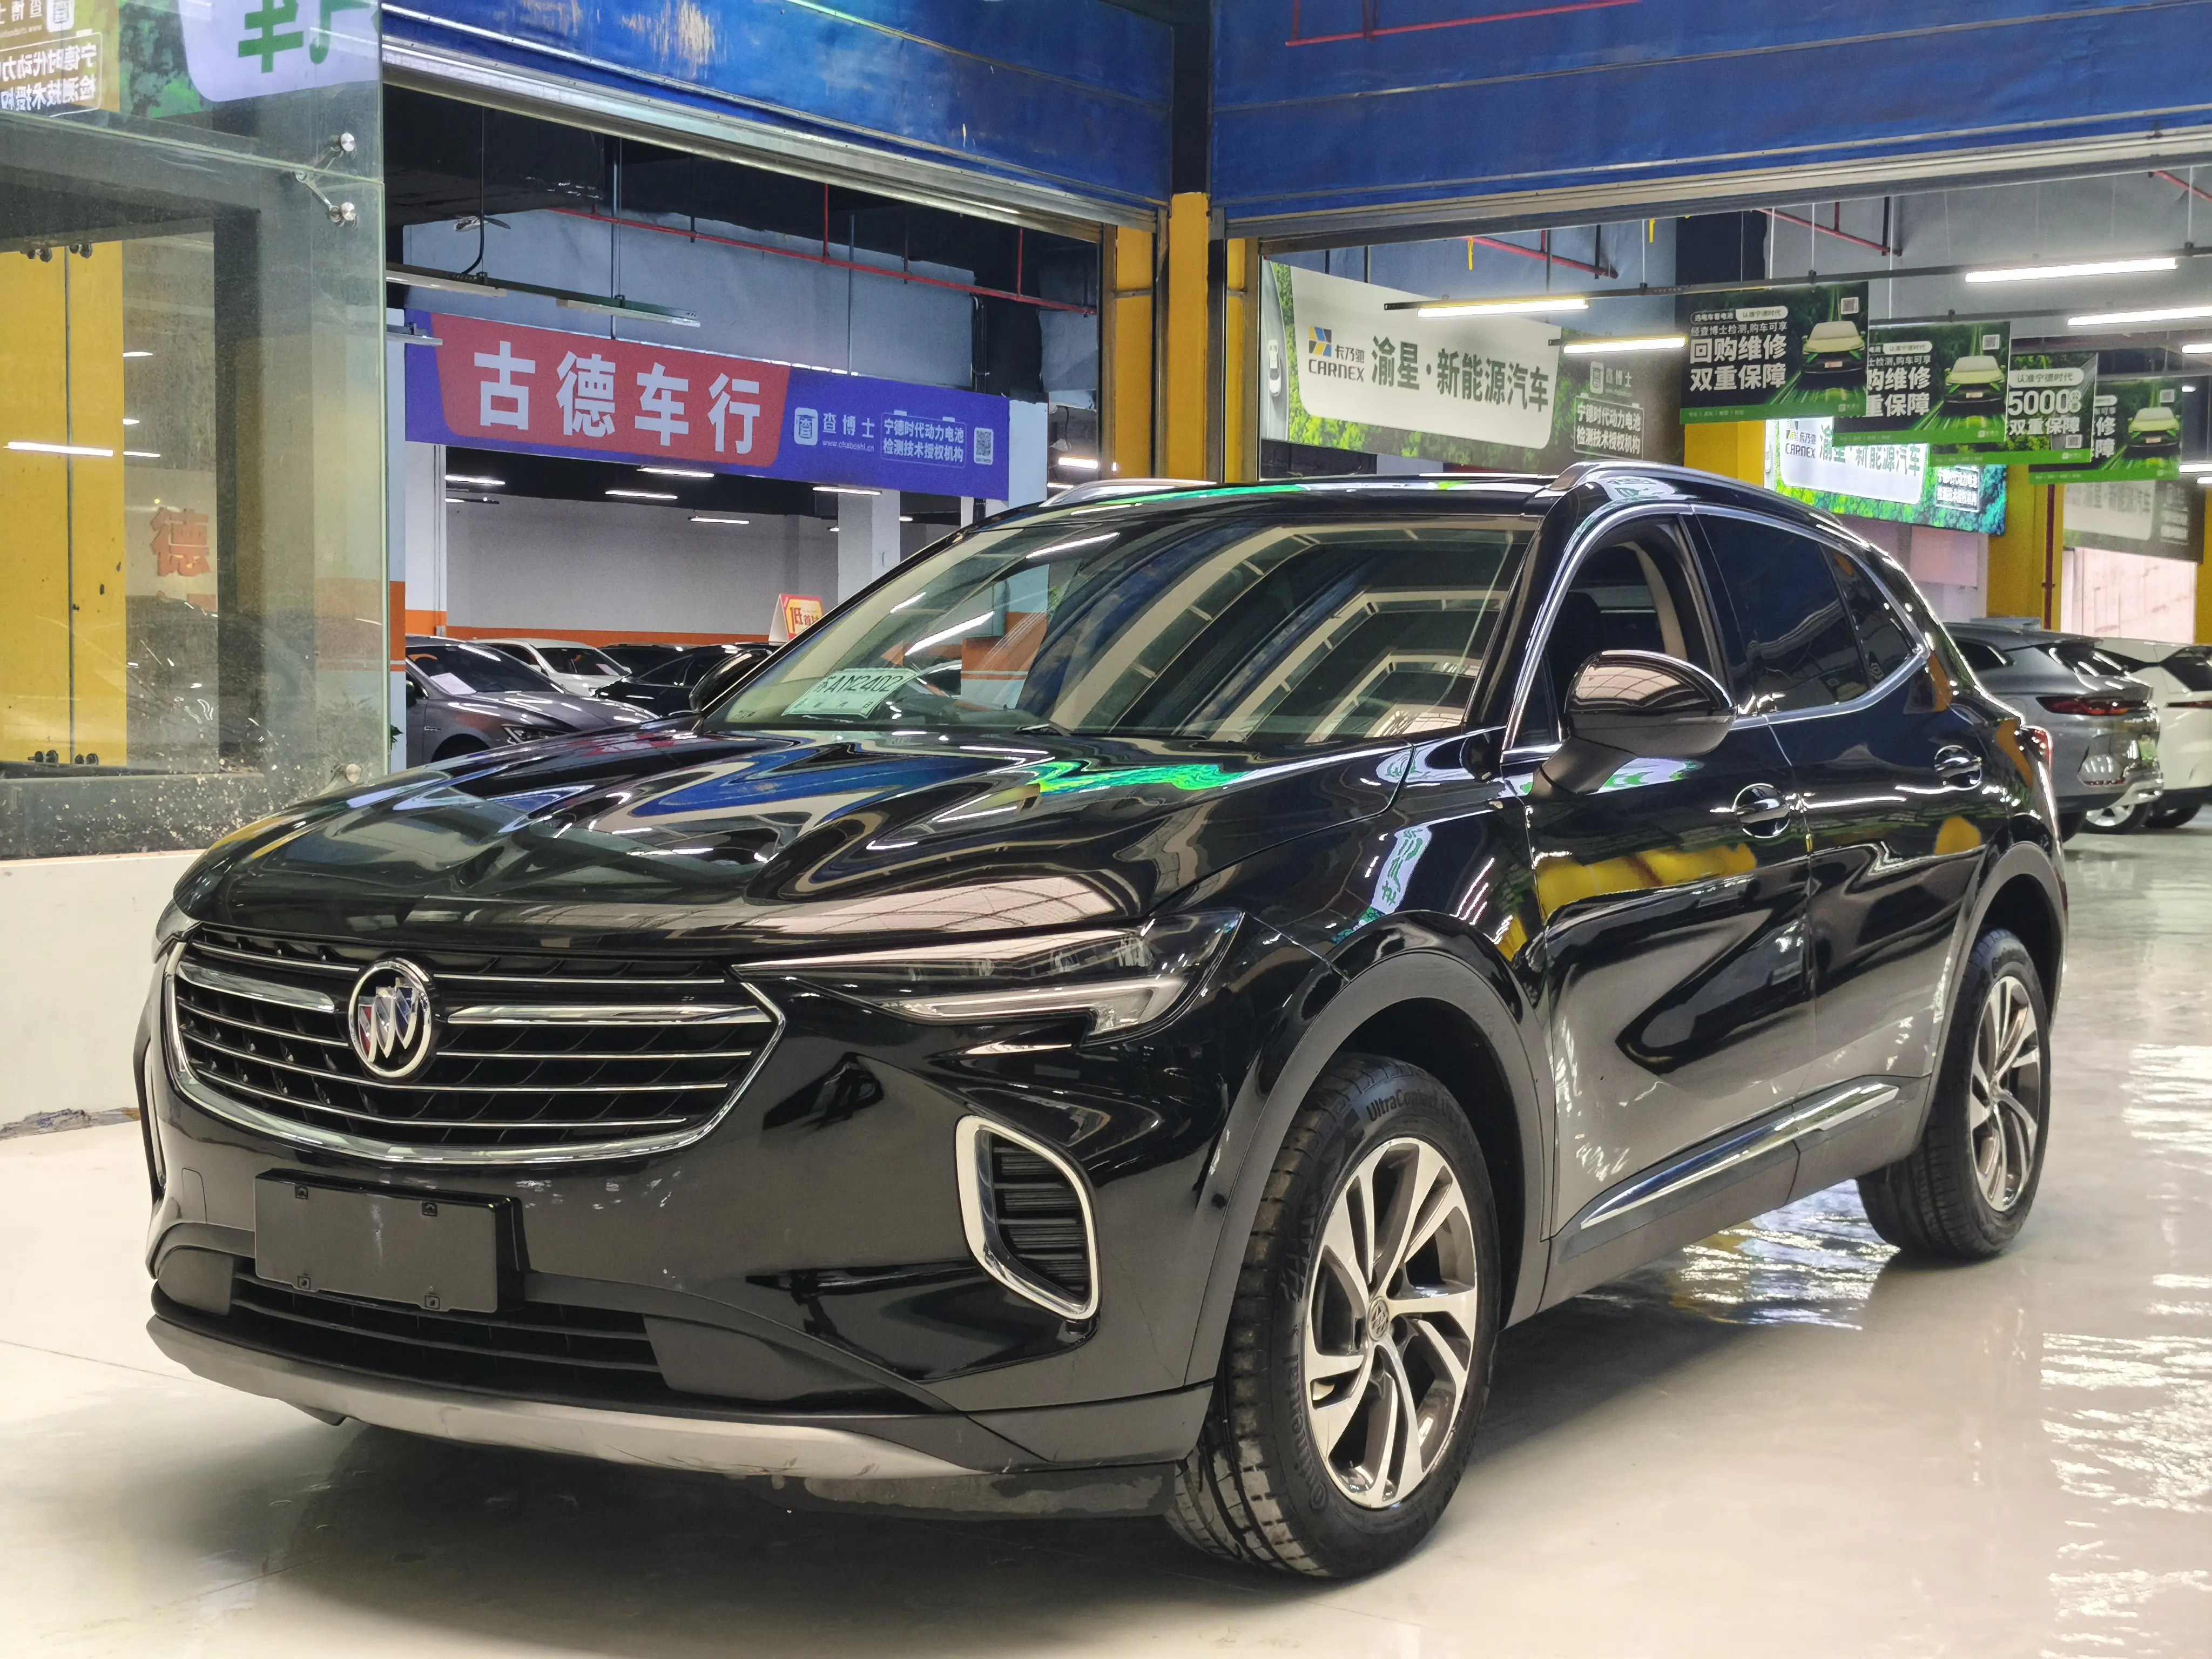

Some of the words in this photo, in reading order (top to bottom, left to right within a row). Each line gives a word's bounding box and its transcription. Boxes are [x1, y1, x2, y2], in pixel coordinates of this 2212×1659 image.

[1690, 334, 1787, 363] 回购维修
[1309, 359, 1364, 382] CARNEX
[1371, 335, 1549, 412] 渝星·新能源汽车
[1690, 362, 1786, 392] 双重保障
[1867, 366, 1931, 392] 购维修
[474, 341, 760, 454] 古德车行
[1866, 392, 1930, 417] 重保障
[2008, 390, 2069, 415] 5000
[822, 413, 875, 439] 查博士
[884, 419, 964, 443] 宁德时代动力电池
[2008, 416, 2080, 436] 双重保障
[2093, 416, 2116, 436] 修
[883, 438, 964, 463] 检测技术授权机构
[1785, 442, 1815, 458] CARNEX
[2093, 438, 2115, 458] 障
